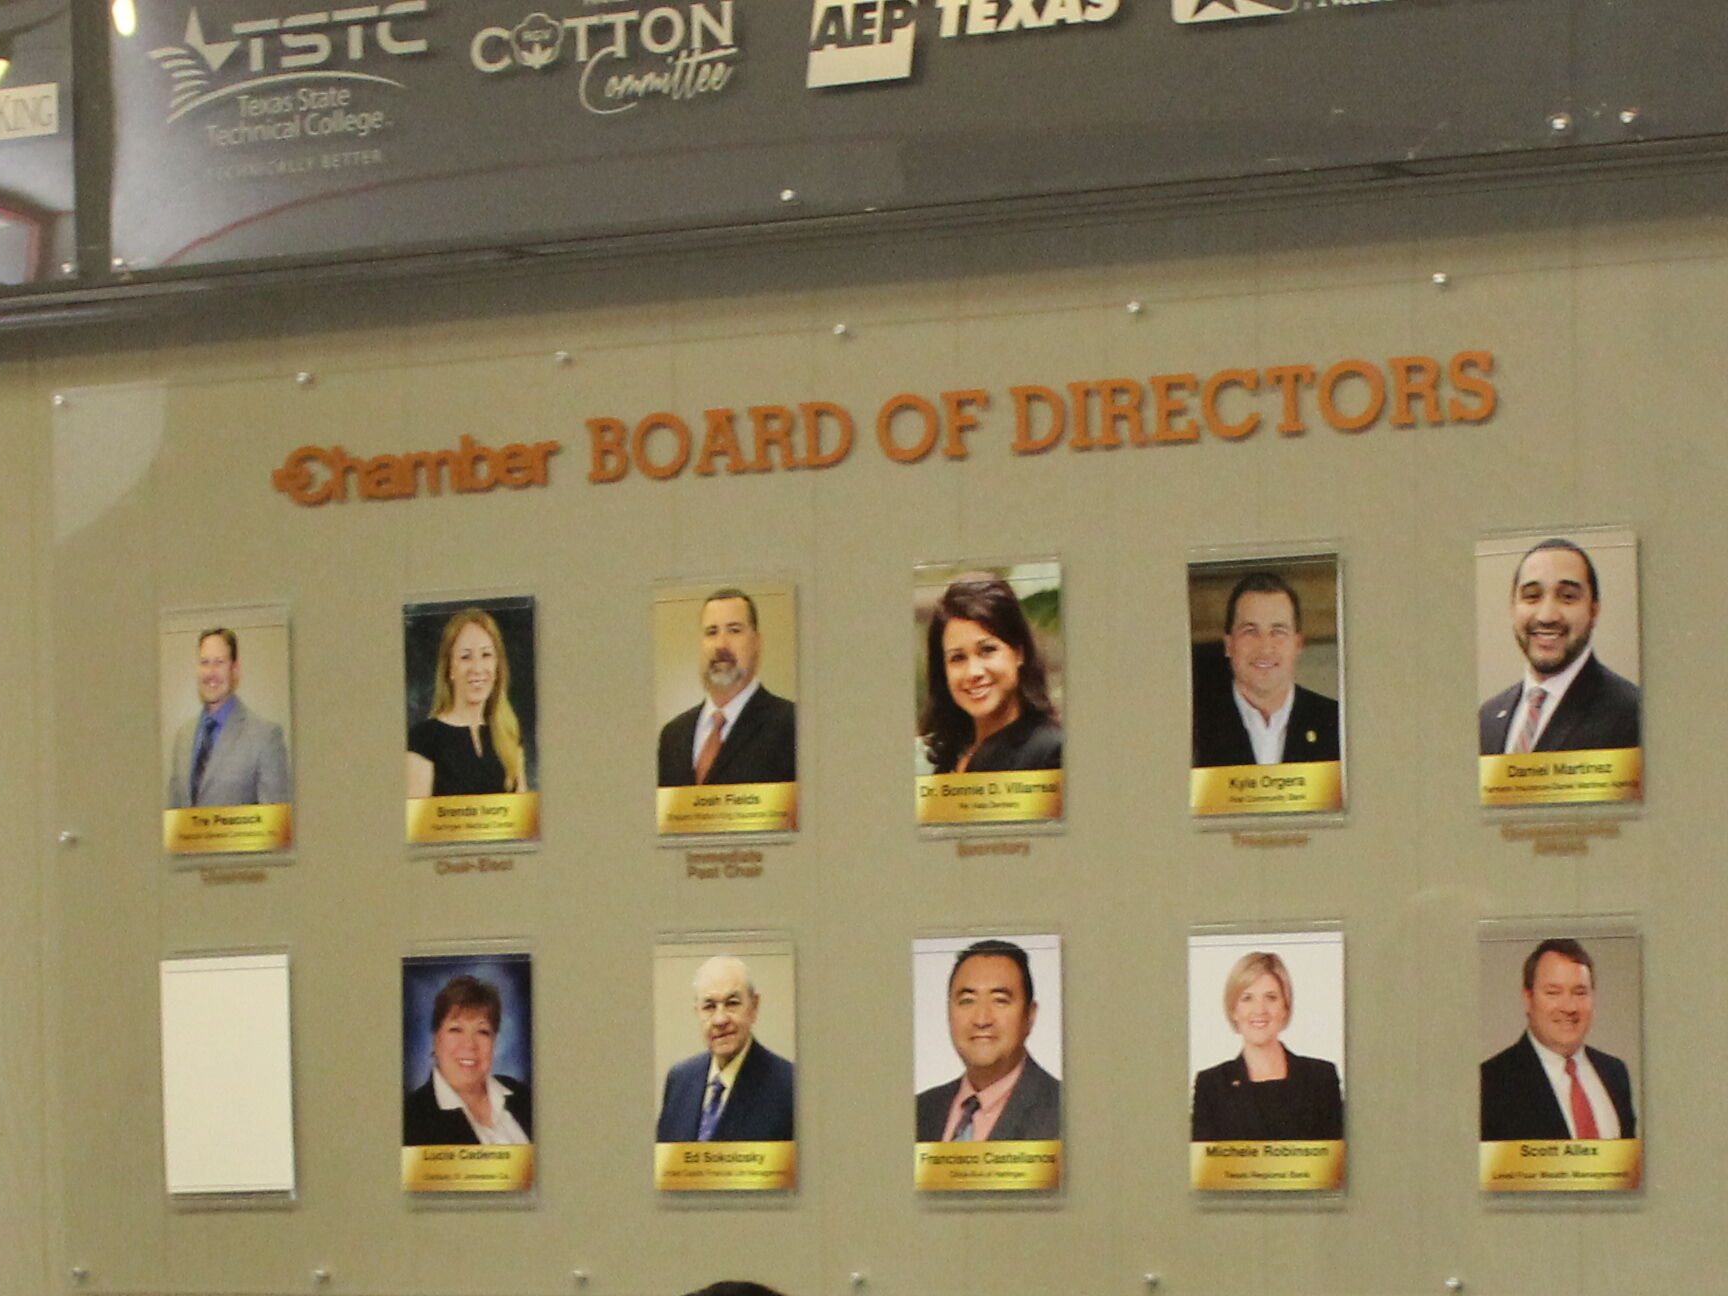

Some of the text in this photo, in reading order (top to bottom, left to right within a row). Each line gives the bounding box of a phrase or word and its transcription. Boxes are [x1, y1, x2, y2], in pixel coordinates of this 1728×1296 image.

[232, 0, 428, 72] TSTC
[809, 0, 1122, 52] AEP TEXAS
[237, 86, 352, 118] Texas State
[579, 46, 739, 115] Committee
[207, 116, 300, 146] Technical
[273, 351, 1499, 508] Chamber BOARD OF DIRECTORS
[1507, 762, 1613, 778] Daniel Martinez
